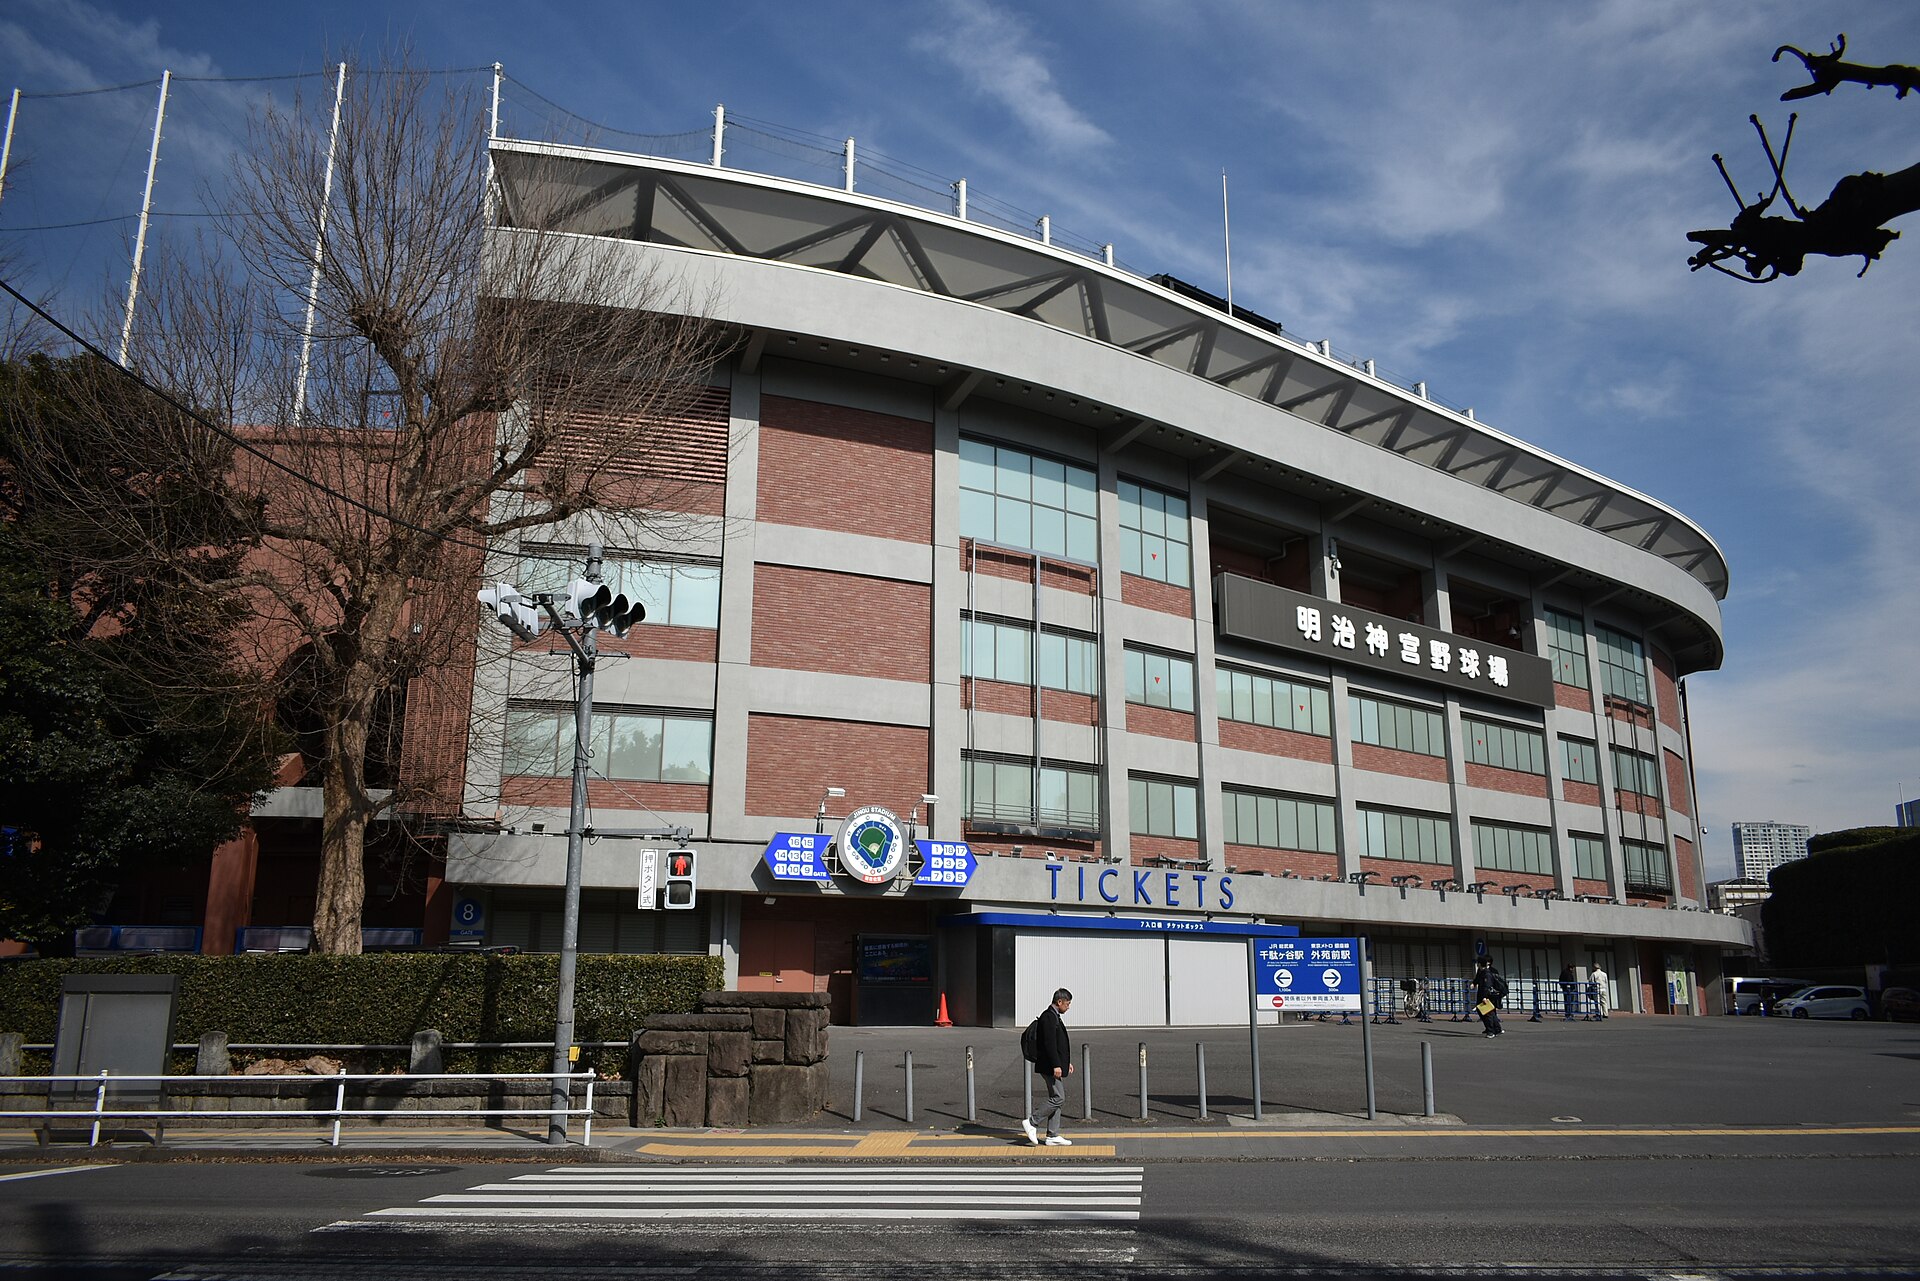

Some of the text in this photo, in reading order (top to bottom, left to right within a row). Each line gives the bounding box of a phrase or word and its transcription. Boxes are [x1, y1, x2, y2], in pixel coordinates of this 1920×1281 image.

[1296, 605, 1510, 688] 明治神宮野球場
[871, 806, 896, 821] STADIUM
[790, 838, 813, 847] 16 15
[776, 851, 813, 860] 14 13 12
[956, 847, 966, 855] 17
[945, 859, 952, 867] 3
[957, 860, 964, 868] 2
[777, 865, 785, 873] 11
[789, 866, 799, 874] 10
[804, 866, 811, 874] 9
[643, 854, 654, 905] 押ボタン式
[1045, 864, 1235, 910] TICKETS
[463, 903, 474, 921] 8
[1166, 922, 1204, 930] チケットボックス
[1477, 942, 1483, 954] 7
[1310, 950, 1351, 960] 外苑前駅
